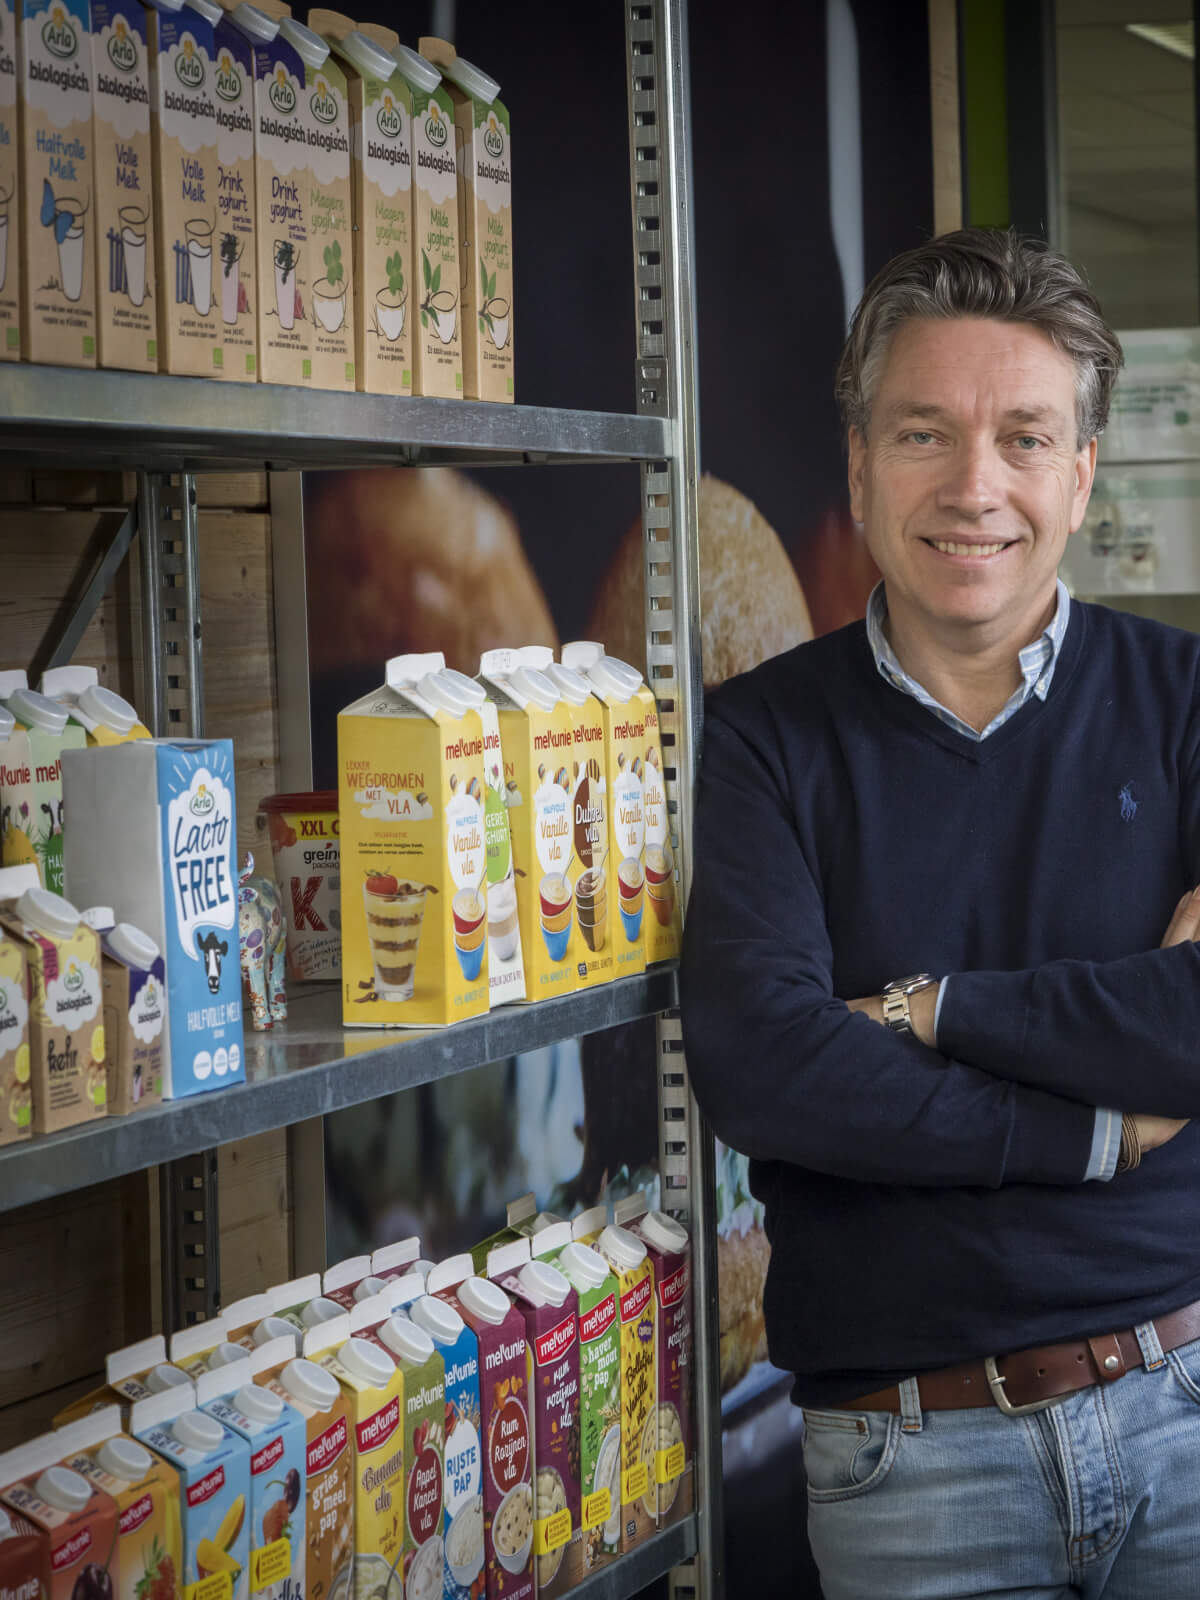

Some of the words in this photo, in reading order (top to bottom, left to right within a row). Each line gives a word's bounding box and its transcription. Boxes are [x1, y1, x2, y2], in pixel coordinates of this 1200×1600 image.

[47, 29, 72, 48] Arla
[112, 43, 133, 61] Arla
[29, 60, 89, 92] biologisch
[179, 59, 200, 77] Arla
[98, 74, 149, 104] biologisch
[217, 73, 237, 93] Arla
[164, 90, 216, 119] biologisch
[273, 87, 292, 105] Arla
[314, 97, 333, 115] Arla
[260, 117, 306, 144] biologisch
[380, 111, 398, 129] Arla
[428, 123, 444, 139] Arla
[36, 129, 86, 160] Halfvolle
[307, 128, 348, 152] iologisch
[487, 133, 501, 149] Arla
[115, 143, 138, 167] Volle
[367, 141, 410, 167] biologisch
[417, 150, 456, 174] biologisch
[49, 157, 77, 181] Melk
[116, 166, 140, 190] Melk
[181, 157, 205, 181] Volle
[477, 161, 511, 185] biologisch
[182, 180, 206, 203] Melk
[271, 176, 299, 203] Drink
[310, 188, 344, 211] Magere
[218, 193, 248, 215] oghurt
[270, 202, 303, 224] yoghurt
[376, 200, 405, 223] Magere
[310, 208, 348, 235] yoghurt
[430, 208, 449, 228] Milde
[487, 217, 504, 236] Milde
[376, 221, 407, 246] yoghurt
[426, 229, 455, 252] yoghurt
[484, 238, 509, 260] yoghurt
[534, 728, 571, 751] melkunie
[614, 720, 645, 740] melkunie
[445, 736, 482, 760] melkunie
[0, 764, 31, 788] lkunie
[346, 760, 370, 771] LEKKER
[346, 773, 425, 788] WEGDROMEN
[193, 798, 211, 809] Arla
[365, 790, 382, 801] MET
[387, 799, 411, 815] VLA
[486, 812, 505, 828] GERE
[575, 800, 605, 825] Dubbel
[619, 801, 642, 825] Vanille
[174, 809, 229, 857] Lacto
[300, 820, 328, 837] XXL
[453, 827, 481, 853] Vanille
[486, 828, 508, 845] GHURT
[540, 815, 569, 841] Vanille
[584, 825, 601, 844] vla
[627, 828, 638, 847] vla
[303, 848, 340, 866] grein
[548, 840, 561, 861] vla
[312, 861, 340, 873] packag
[461, 854, 475, 876] vla
[176, 854, 230, 921] FREE
[56, 995, 93, 1013] biologisch
[137, 1010, 161, 1024] biologisch
[187, 1004, 226, 1032] HALFVOLLE
[47, 1035, 78, 1072] kefir
[663, 1269, 689, 1299] melkunie
[623, 1282, 650, 1315] melkunie
[583, 1301, 615, 1335] melkunie
[673, 1303, 687, 1326] rum
[540, 1321, 574, 1358] melkunie
[667, 1323, 691, 1350] rozijnen
[485, 1338, 525, 1371] melkunie
[588, 1336, 613, 1364] haver
[597, 1347, 617, 1372] mout
[677, 1343, 688, 1367] vla
[553, 1360, 571, 1385] rum
[594, 1370, 609, 1390] pap
[407, 1382, 443, 1416] melkunie
[546, 1379, 578, 1411] rozijnen
[626, 1377, 648, 1418] Vanille
[361, 1402, 399, 1445] melkunie
[560, 1400, 573, 1429] vla
[636, 1404, 647, 1424] vla
[501, 1417, 519, 1439] Rum
[253, 1441, 282, 1470] melkunie
[307, 1425, 346, 1467] melkunie
[494, 1435, 526, 1466] Rozijnen
[415, 1457, 437, 1488] Appel
[446, 1446, 477, 1477] RIJSTE
[504, 1460, 517, 1481] vla
[189, 1470, 224, 1500] melkunie
[312, 1469, 338, 1511] gries
[454, 1472, 471, 1497] PAP
[323, 1483, 347, 1513] meel
[374, 1485, 392, 1516] vla
[413, 1481, 439, 1513] Kaneel
[120, 1498, 152, 1528] melkunie
[320, 1509, 338, 1538] pap
[420, 1509, 433, 1531] vla
[54, 1530, 91, 1566] melkunie
